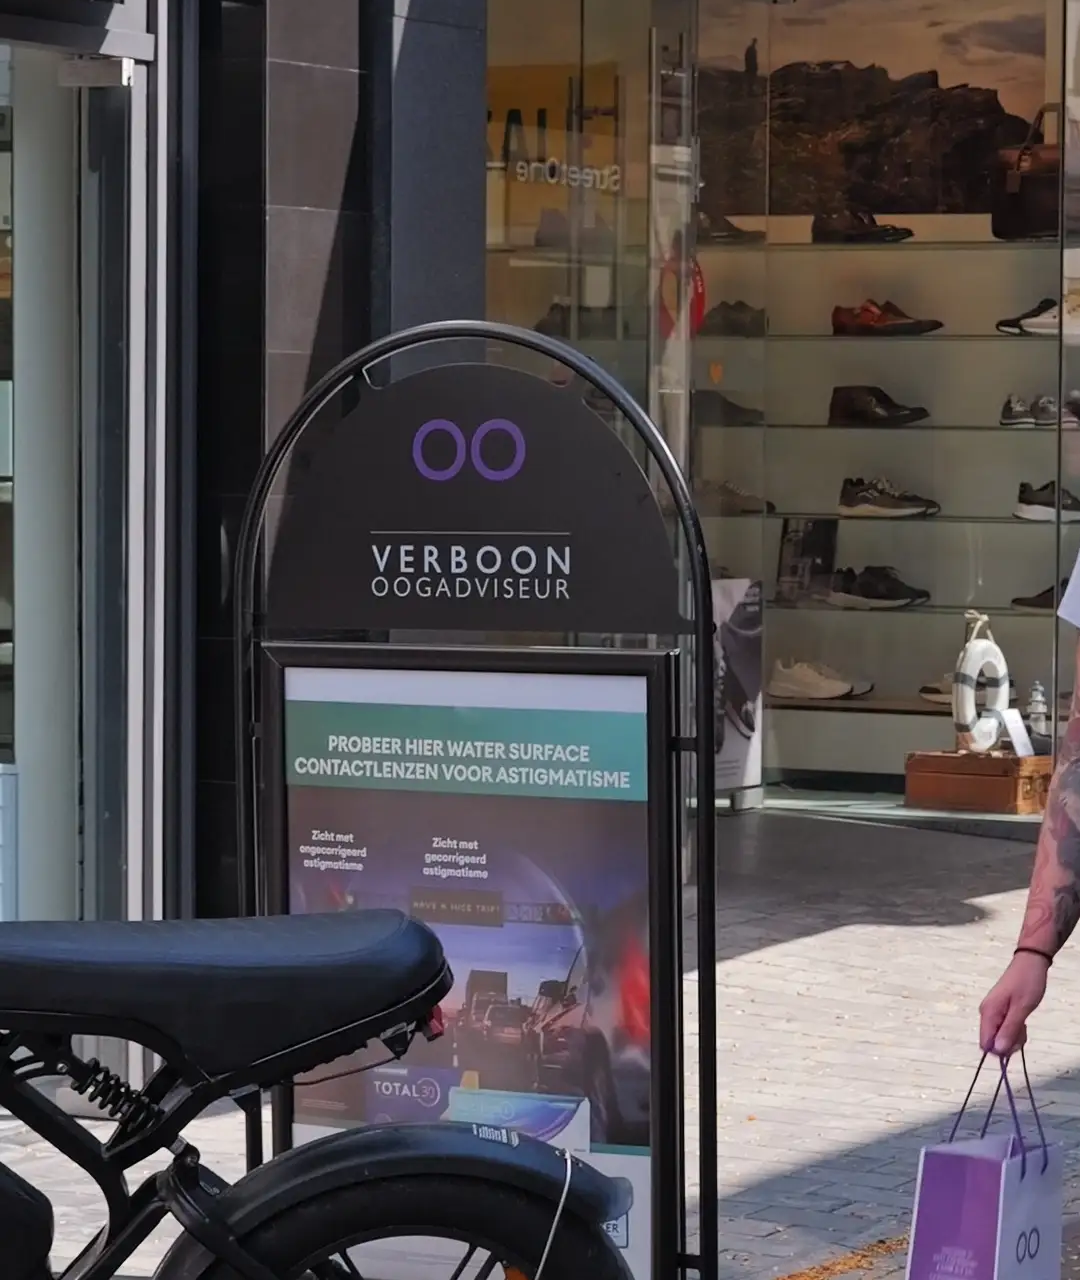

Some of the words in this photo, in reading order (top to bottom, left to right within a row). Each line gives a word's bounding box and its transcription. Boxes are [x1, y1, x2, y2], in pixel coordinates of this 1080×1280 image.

[371, 544, 572, 575] VERBOON
[371, 576, 571, 600] OOGADVISEUR
[328, 734, 402, 755] PROBEER
[405, 738, 444, 757] HIER
[447, 740, 507, 760] WATER
[509, 743, 590, 762] SURFACE
[294, 756, 438, 780] CONTACTLENZEN
[441, 763, 494, 783] VOOR
[495, 767, 631, 789] ASTIGMATISME
[311, 829, 335, 842] Zicht
[336, 833, 354, 843] met
[432, 837, 457, 850] Zicht
[459, 840, 479, 850] met
[303, 858, 364, 871] astigmatisme
[424, 852, 487, 866] gecorrigeerd
[422, 866, 489, 880] astigmatisme
